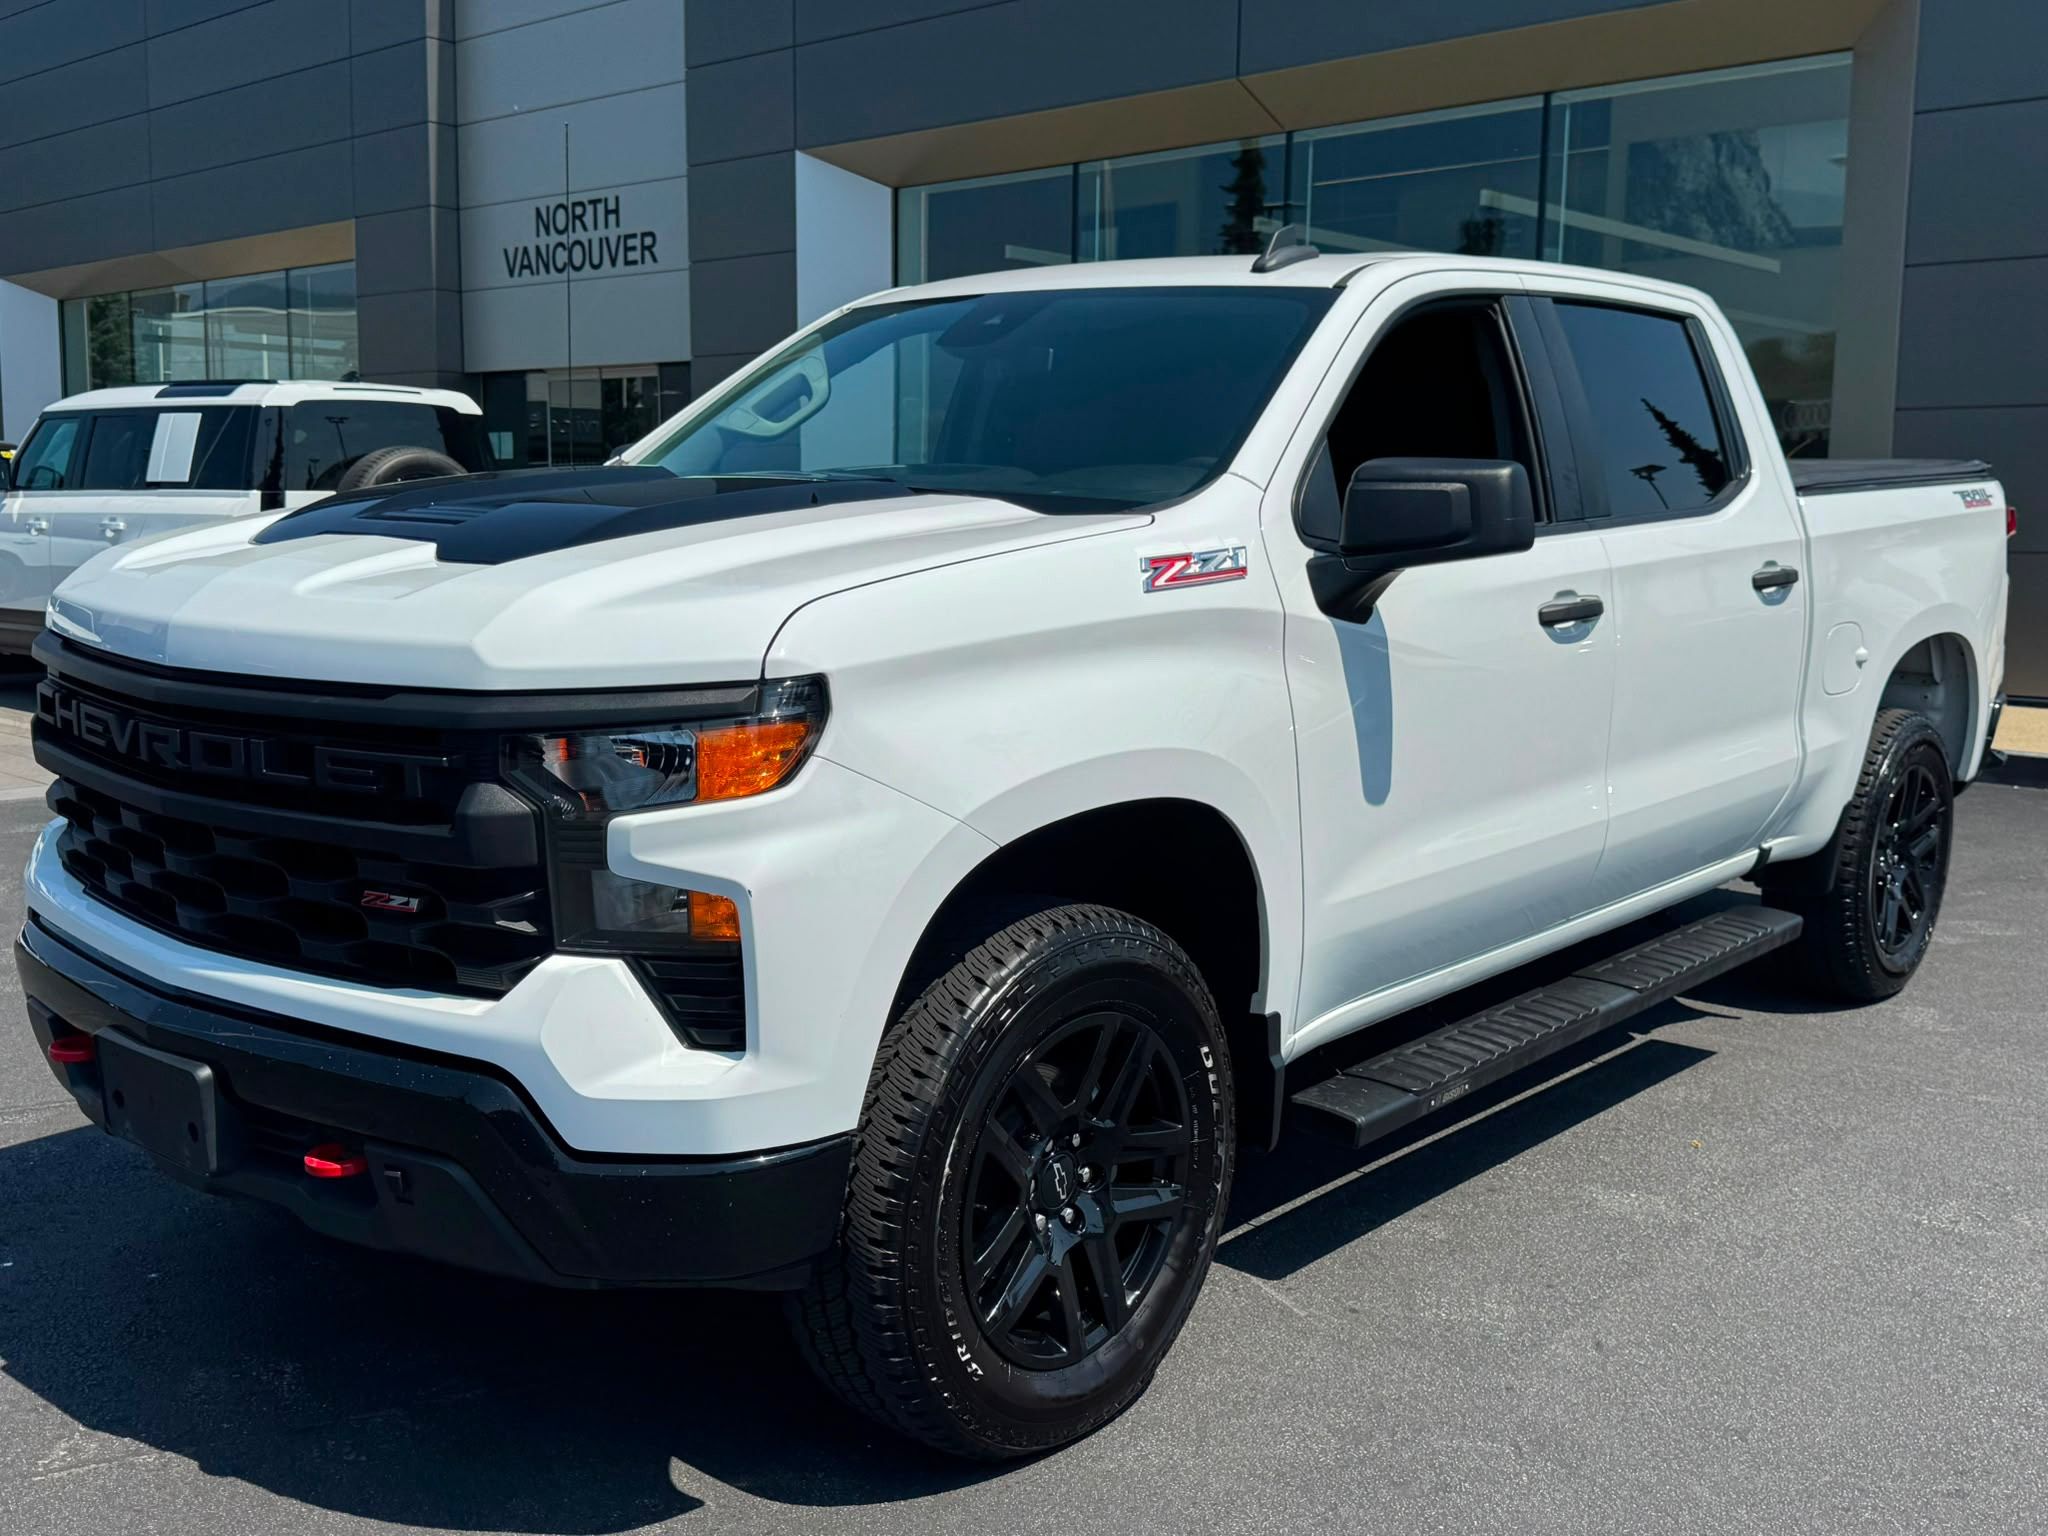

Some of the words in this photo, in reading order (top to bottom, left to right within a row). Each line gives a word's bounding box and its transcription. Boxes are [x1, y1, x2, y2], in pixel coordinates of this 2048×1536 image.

[535, 195, 620, 238] NORTH
[503, 231, 658, 279] VANCOUVER
[1140, 546, 1248, 593] Z71
[36, 682, 464, 798] CHEVROLET
[361, 890, 419, 912] Z71
